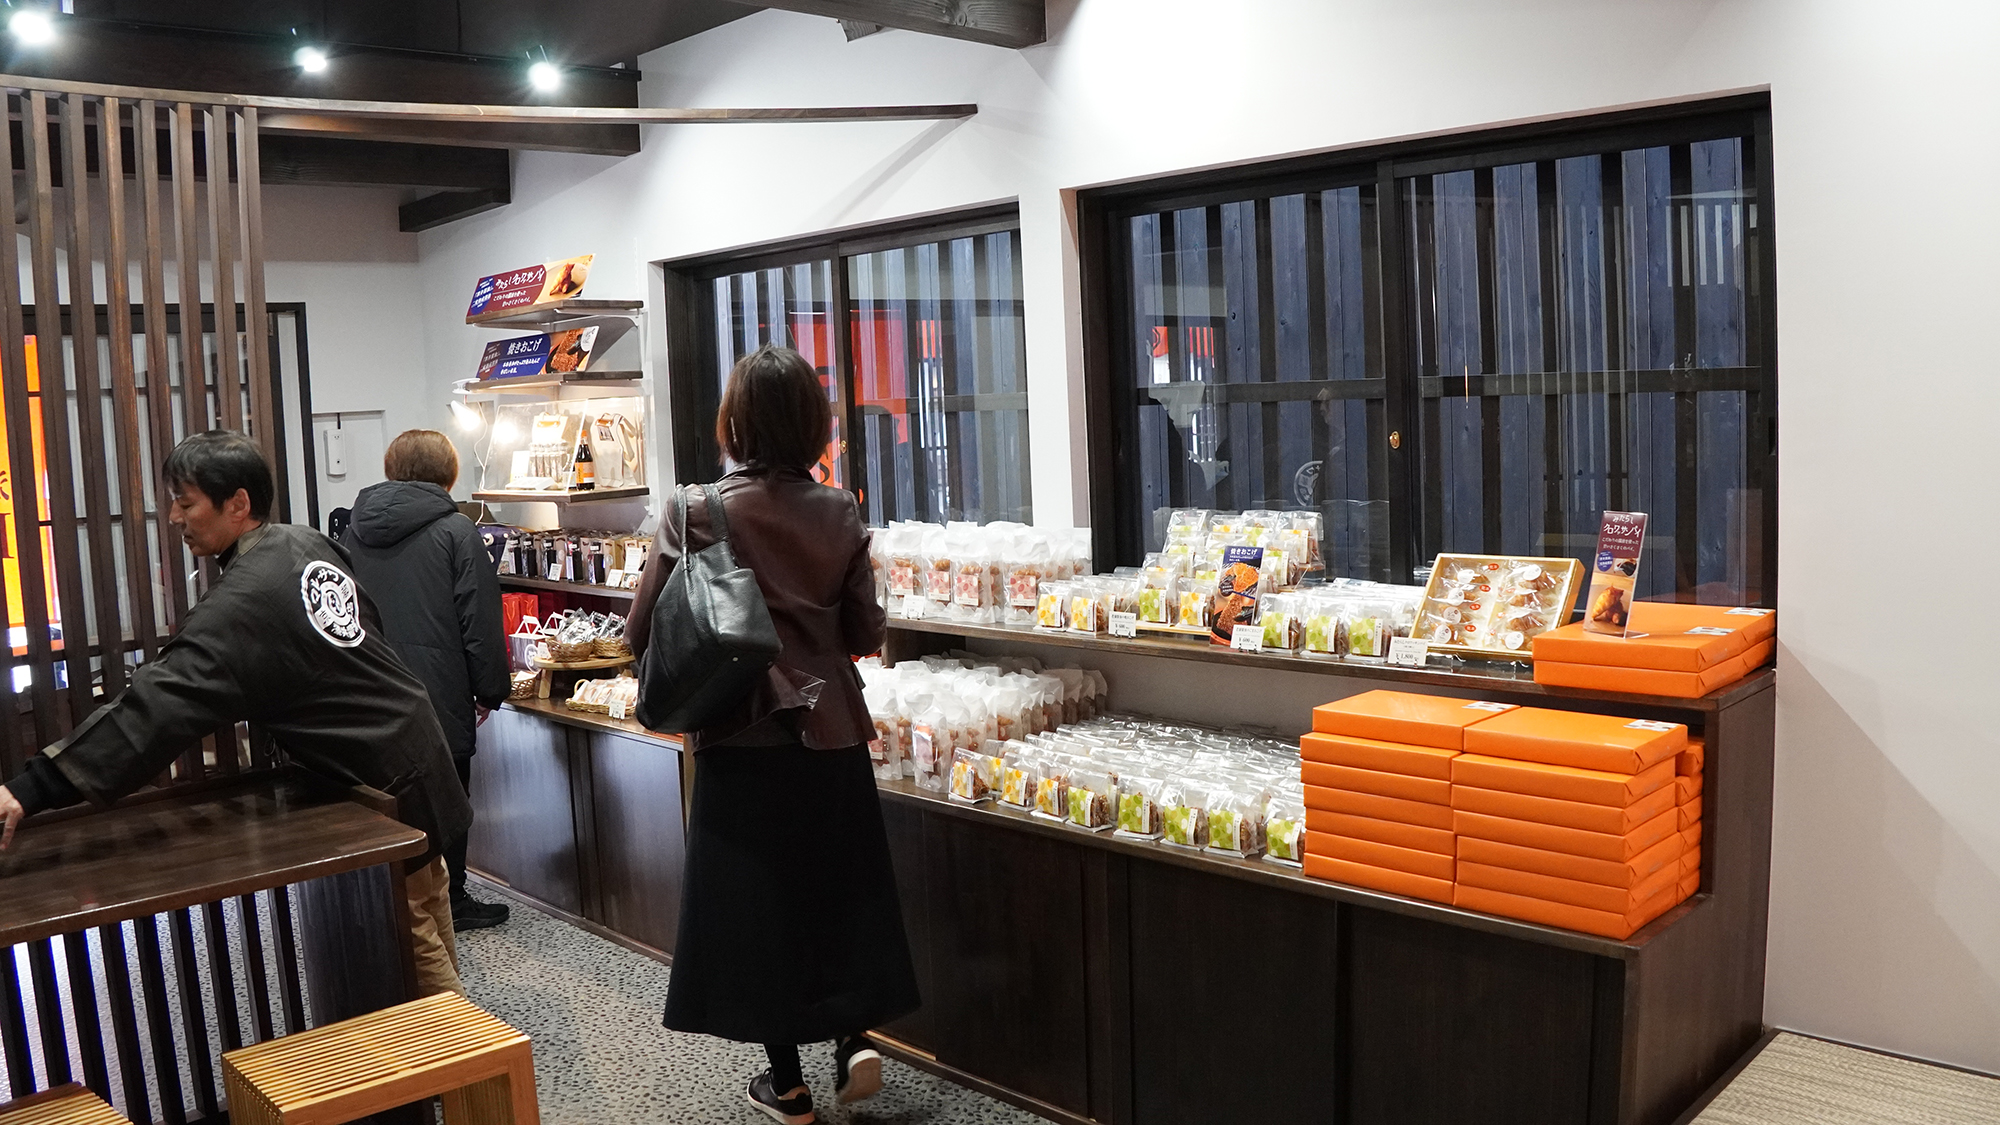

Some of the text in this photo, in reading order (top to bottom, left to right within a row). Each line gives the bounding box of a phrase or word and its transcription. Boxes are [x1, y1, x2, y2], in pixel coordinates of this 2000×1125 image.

[507, 337, 543, 355] 焼きおこげ
[1612, 513, 1634, 524] みたらし
[1603, 523, 1642, 537] クロワッサンパイ
[1230, 548, 1258, 556] 焼きおこげ
